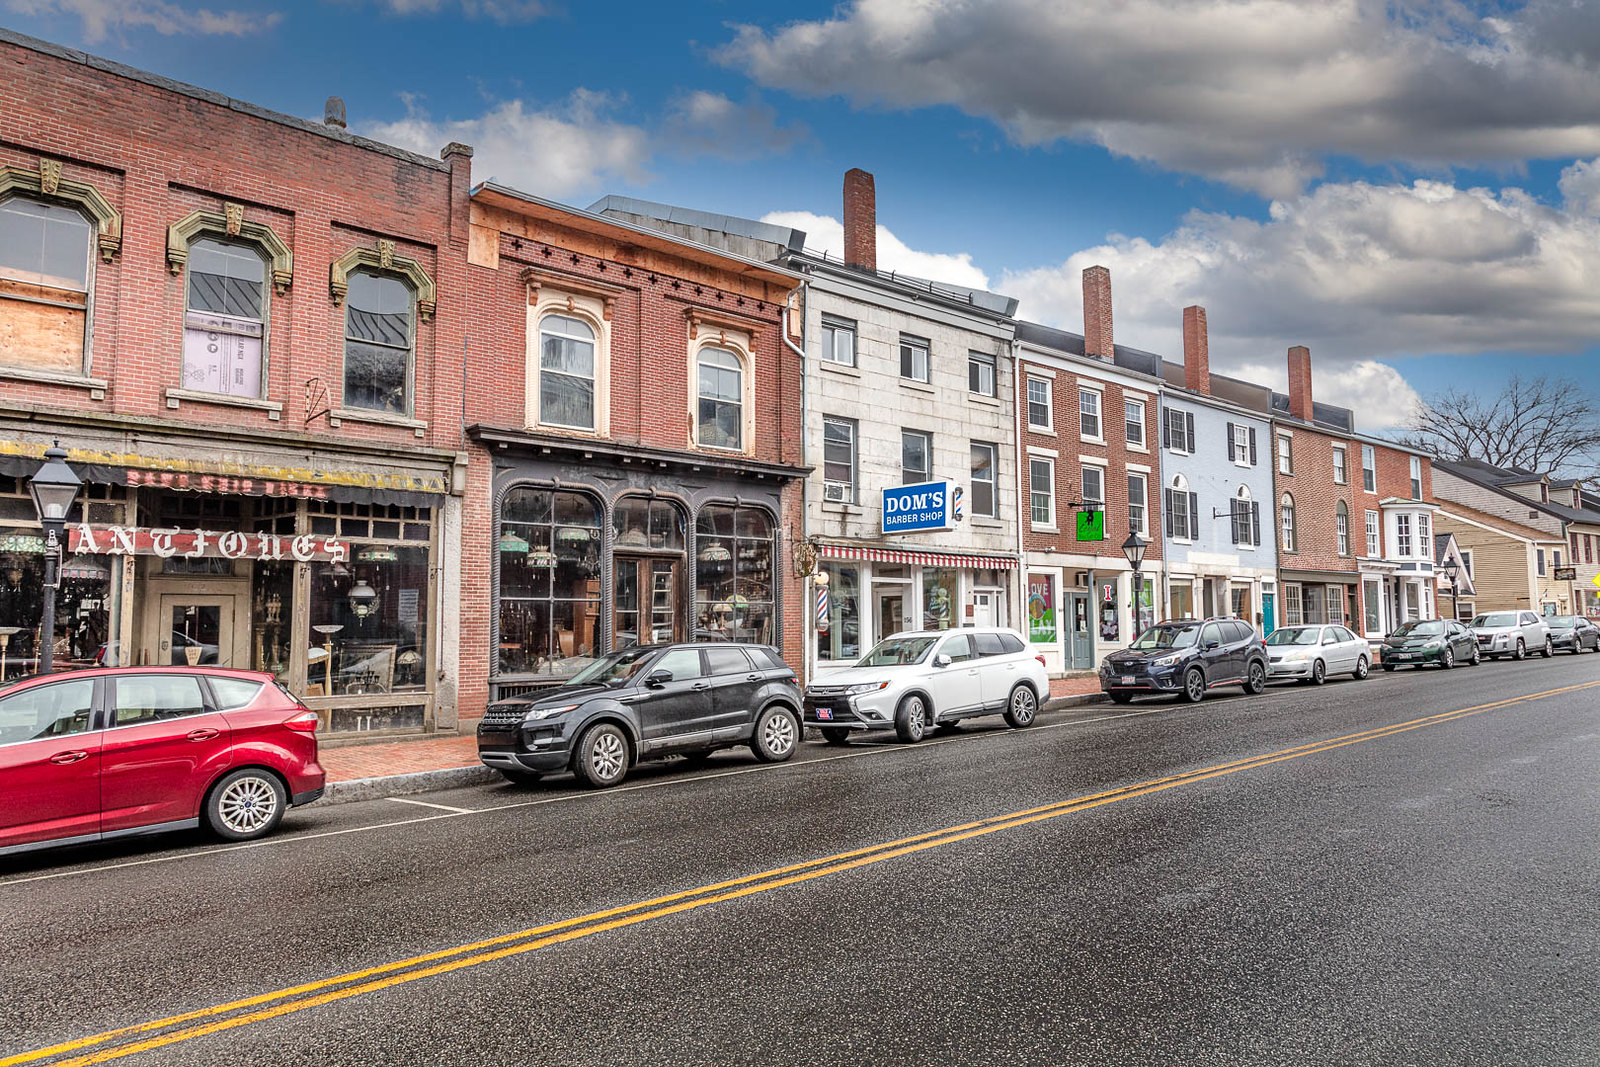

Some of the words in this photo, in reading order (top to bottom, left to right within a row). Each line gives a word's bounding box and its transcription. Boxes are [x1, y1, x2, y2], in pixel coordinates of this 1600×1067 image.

[886, 491, 944, 513] DOM'S
[886, 513, 918, 525] BARBER
[919, 511, 943, 522] SHOP
[75, 523, 345, 564] ANTIQUES
[1030, 583, 1049, 596] OVE
